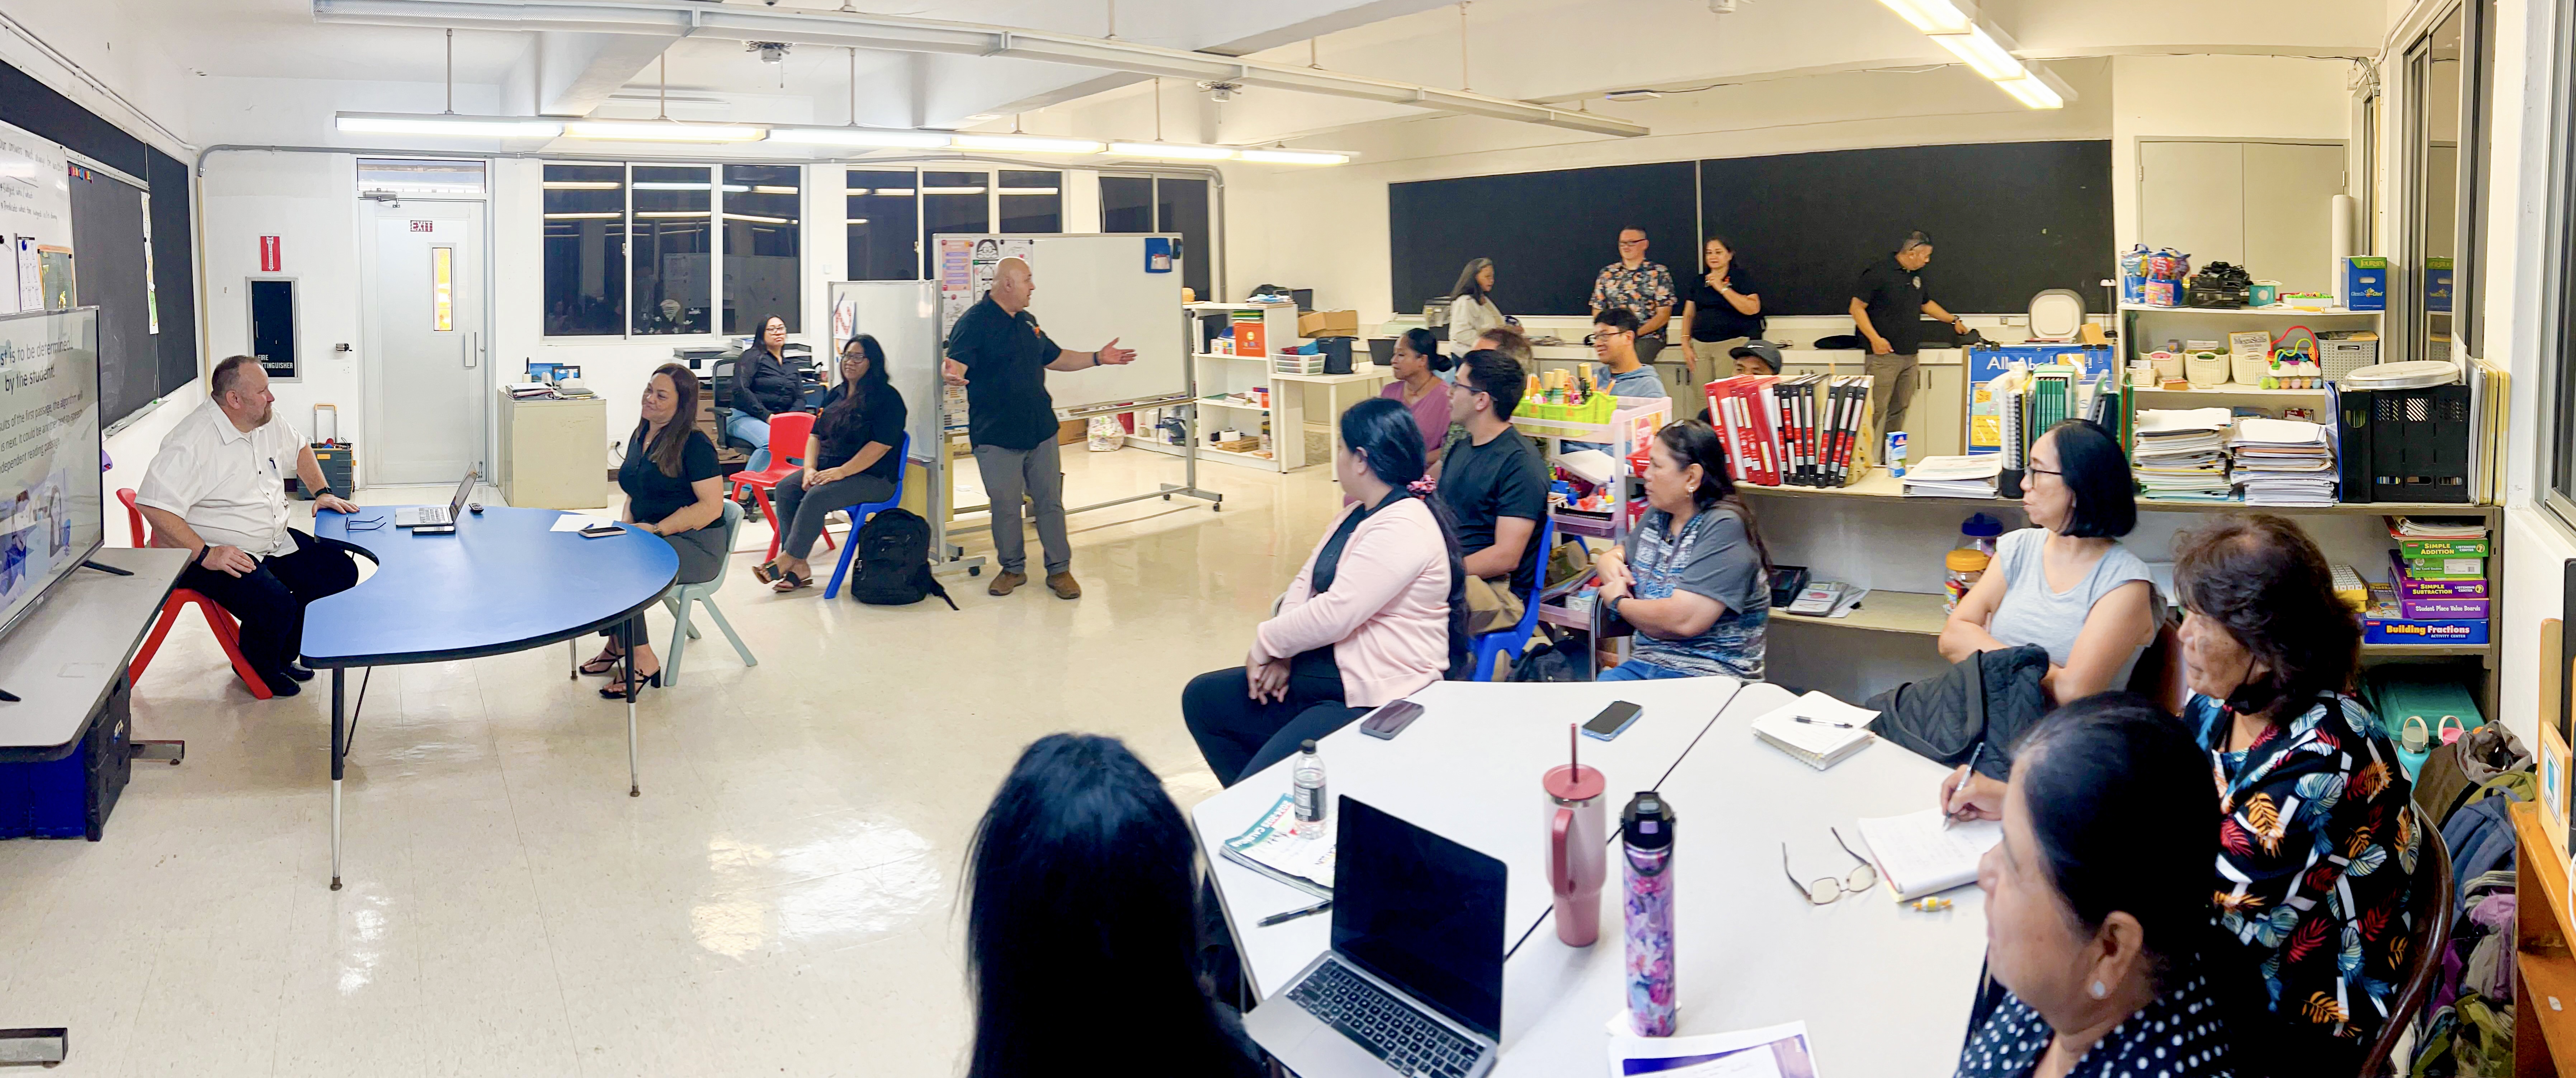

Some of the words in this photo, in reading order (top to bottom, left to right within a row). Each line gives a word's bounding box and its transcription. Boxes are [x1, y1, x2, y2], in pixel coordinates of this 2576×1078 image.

[411, 221, 432, 231] EXIT
[10, 346, 15, 363] is
[18, 347, 24, 361] to
[27, 344, 35, 359] be
[1986, 356, 2009, 370] All
[2017, 356, 2055, 371] Abt
[5, 375, 14, 395] by
[16, 371, 28, 388] the
[30, 363, 55, 384] student!
[11, 414, 16, 427] of
[26, 410, 34, 421] first
[23, 428, 35, 442] could
[36, 426, 41, 436] be
[28, 445, 43, 457] reading
[44, 438, 60, 454] passage
[2386, 625, 2426, 635] Building
[2427, 625, 2470, 634] Fractions
[1260, 800, 1292, 828] 2024-2025
[1229, 827, 1265, 847] CALENDAR
